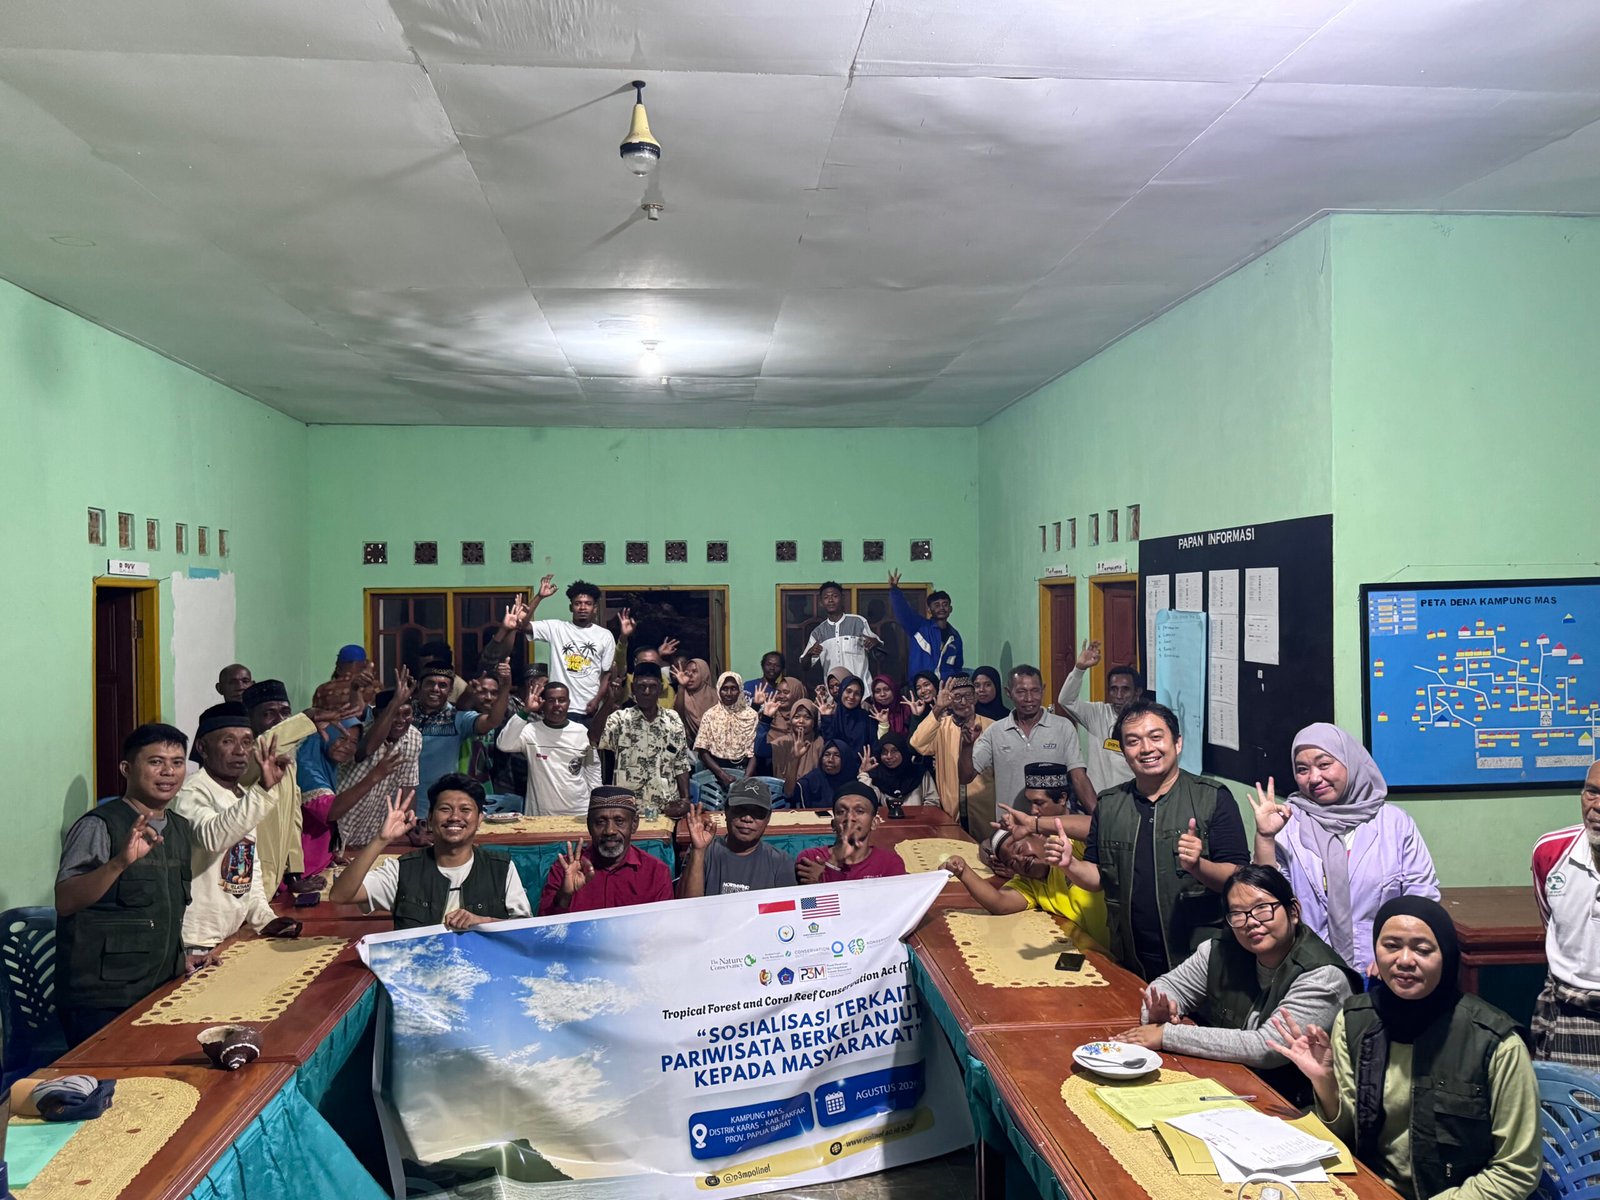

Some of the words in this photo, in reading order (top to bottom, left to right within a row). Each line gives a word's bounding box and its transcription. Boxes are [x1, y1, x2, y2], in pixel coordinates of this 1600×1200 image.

[1178, 534, 1204, 550] PAPAN
[1207, 527, 1255, 546] INFORMASI
[1420, 598, 1447, 607] PETA
[1450, 597, 1477, 606] DENA
[1479, 595, 1532, 606] KAMPUNG
[1534, 595, 1557, 605] MAS
[800, 965, 825, 980] P3M
[662, 1005, 706, 1020] Tropical
[708, 1001, 741, 1014] Forest
[743, 998, 762, 1009] and
[765, 994, 792, 1006] Coral
[794, 990, 818, 1002] Reef
[819, 971, 879, 999] Conservation
[881, 964, 897, 977] Act
[835, 984, 912, 1019] TERKAIT
[661, 1036, 786, 1073] PARIWISATA
[694, 1059, 776, 1088] KEPADA
[856, 1084, 896, 1101] AGUSTUS
[708, 1126, 736, 1137] DISTRIK
[736, 1122, 760, 1133] KARAS
[781, 1107, 806, 1121] FAKFAK
[730, 1111, 766, 1124] KAMPUNG
[725, 1134, 746, 1144] PROV.
[747, 1128, 770, 1140] PAPUA
[770, 1119, 792, 1132] BARAT
